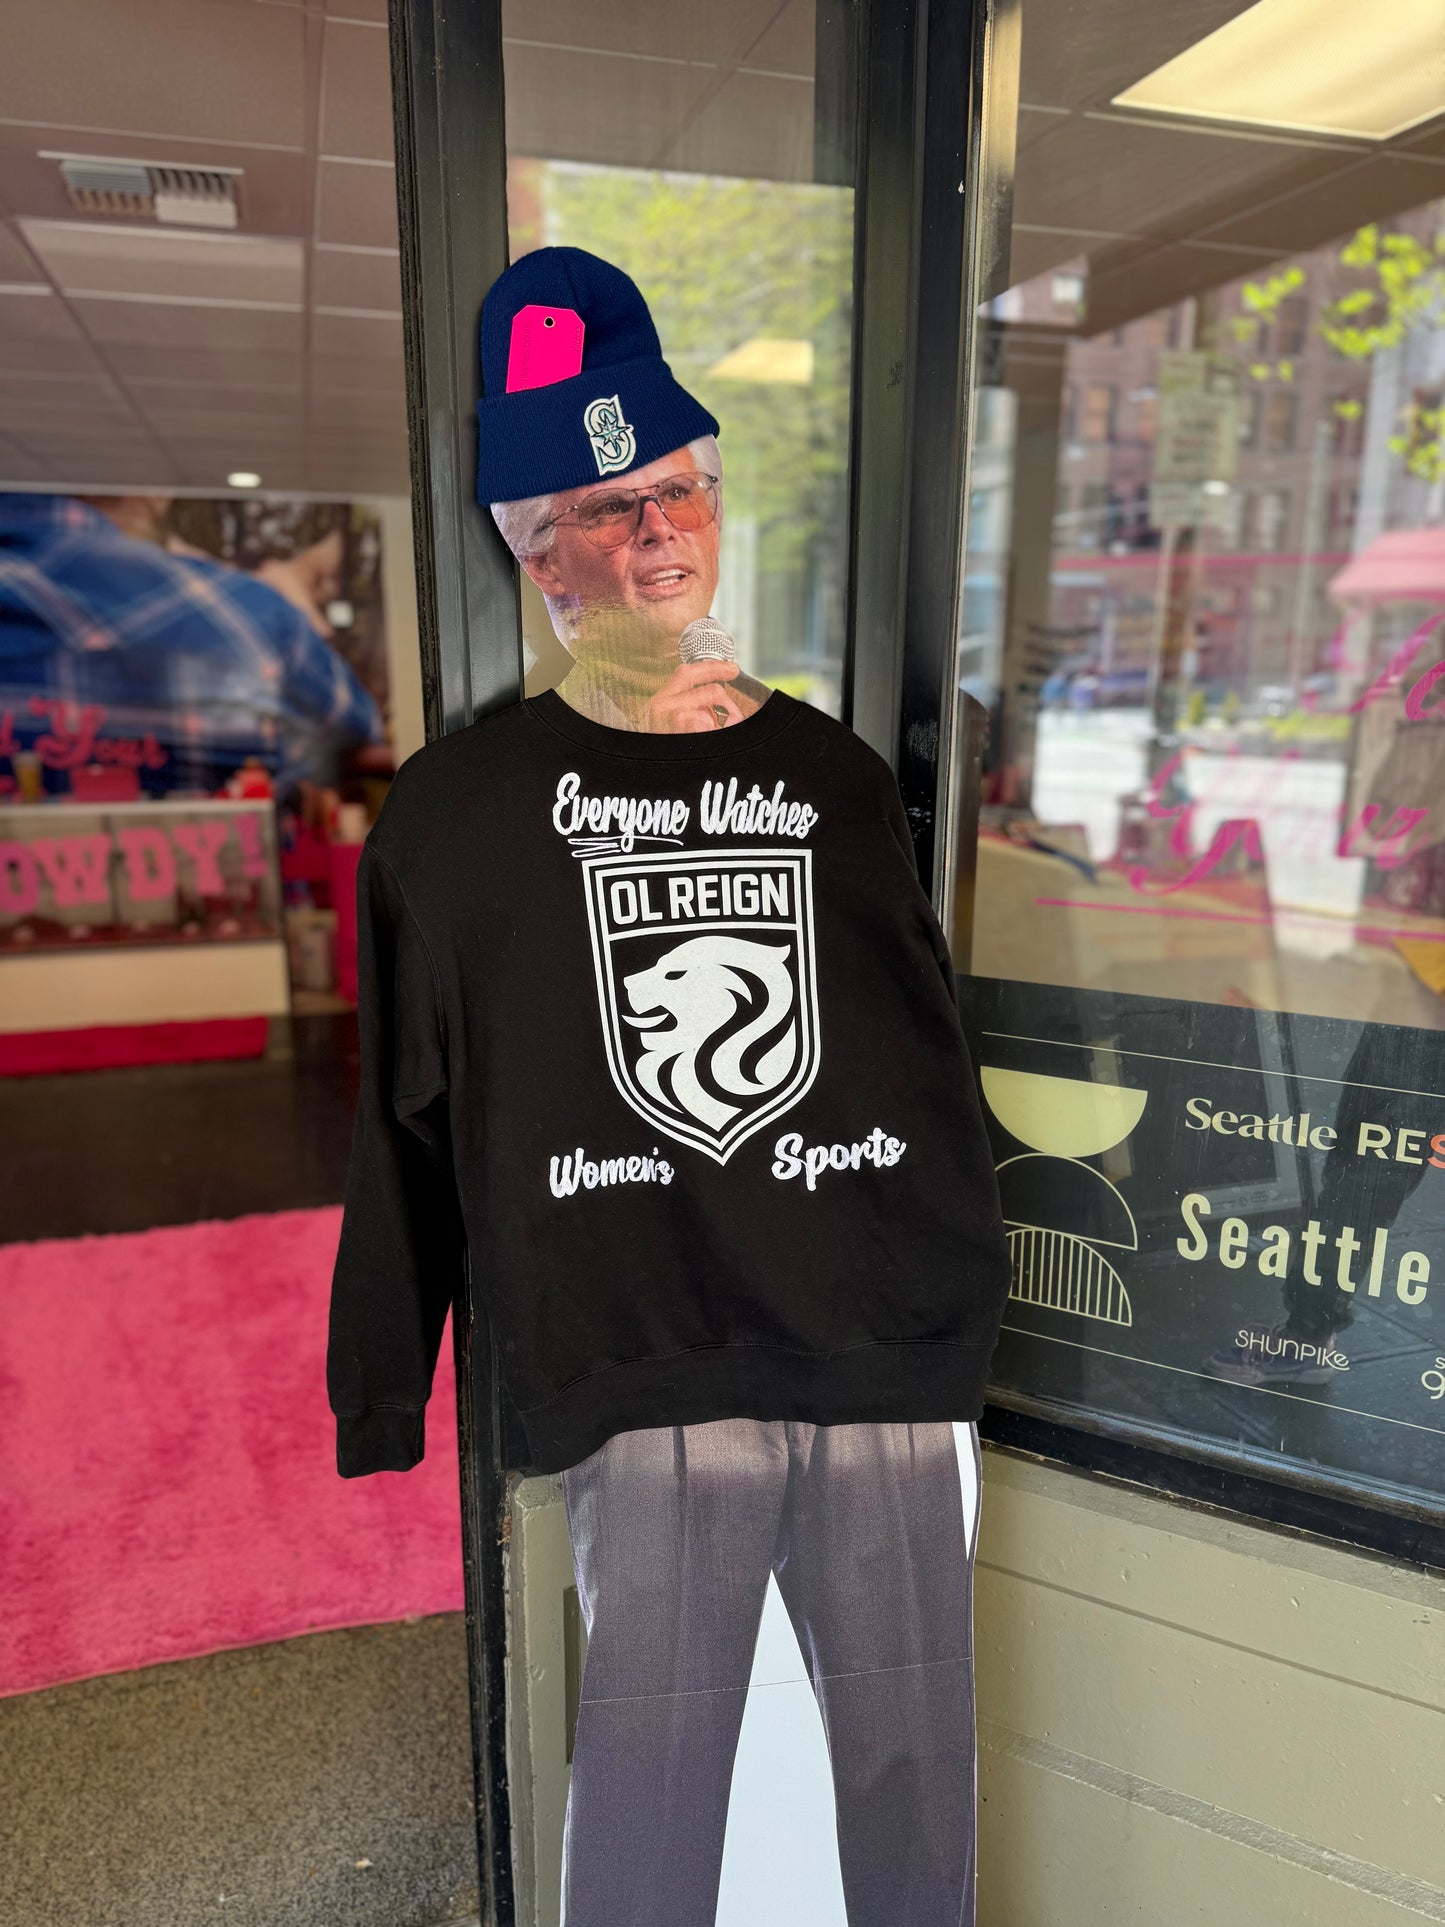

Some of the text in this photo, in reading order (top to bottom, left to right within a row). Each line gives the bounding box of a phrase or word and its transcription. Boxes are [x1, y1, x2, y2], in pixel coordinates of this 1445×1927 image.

[553, 772, 818, 854] Everyone Watches
[610, 873, 789, 925] OL REIGN
[1185, 1097, 1338, 1151] Seattle
[549, 1127, 906, 1198] Women's Sports
[1177, 1193, 1431, 1305] Seattle
